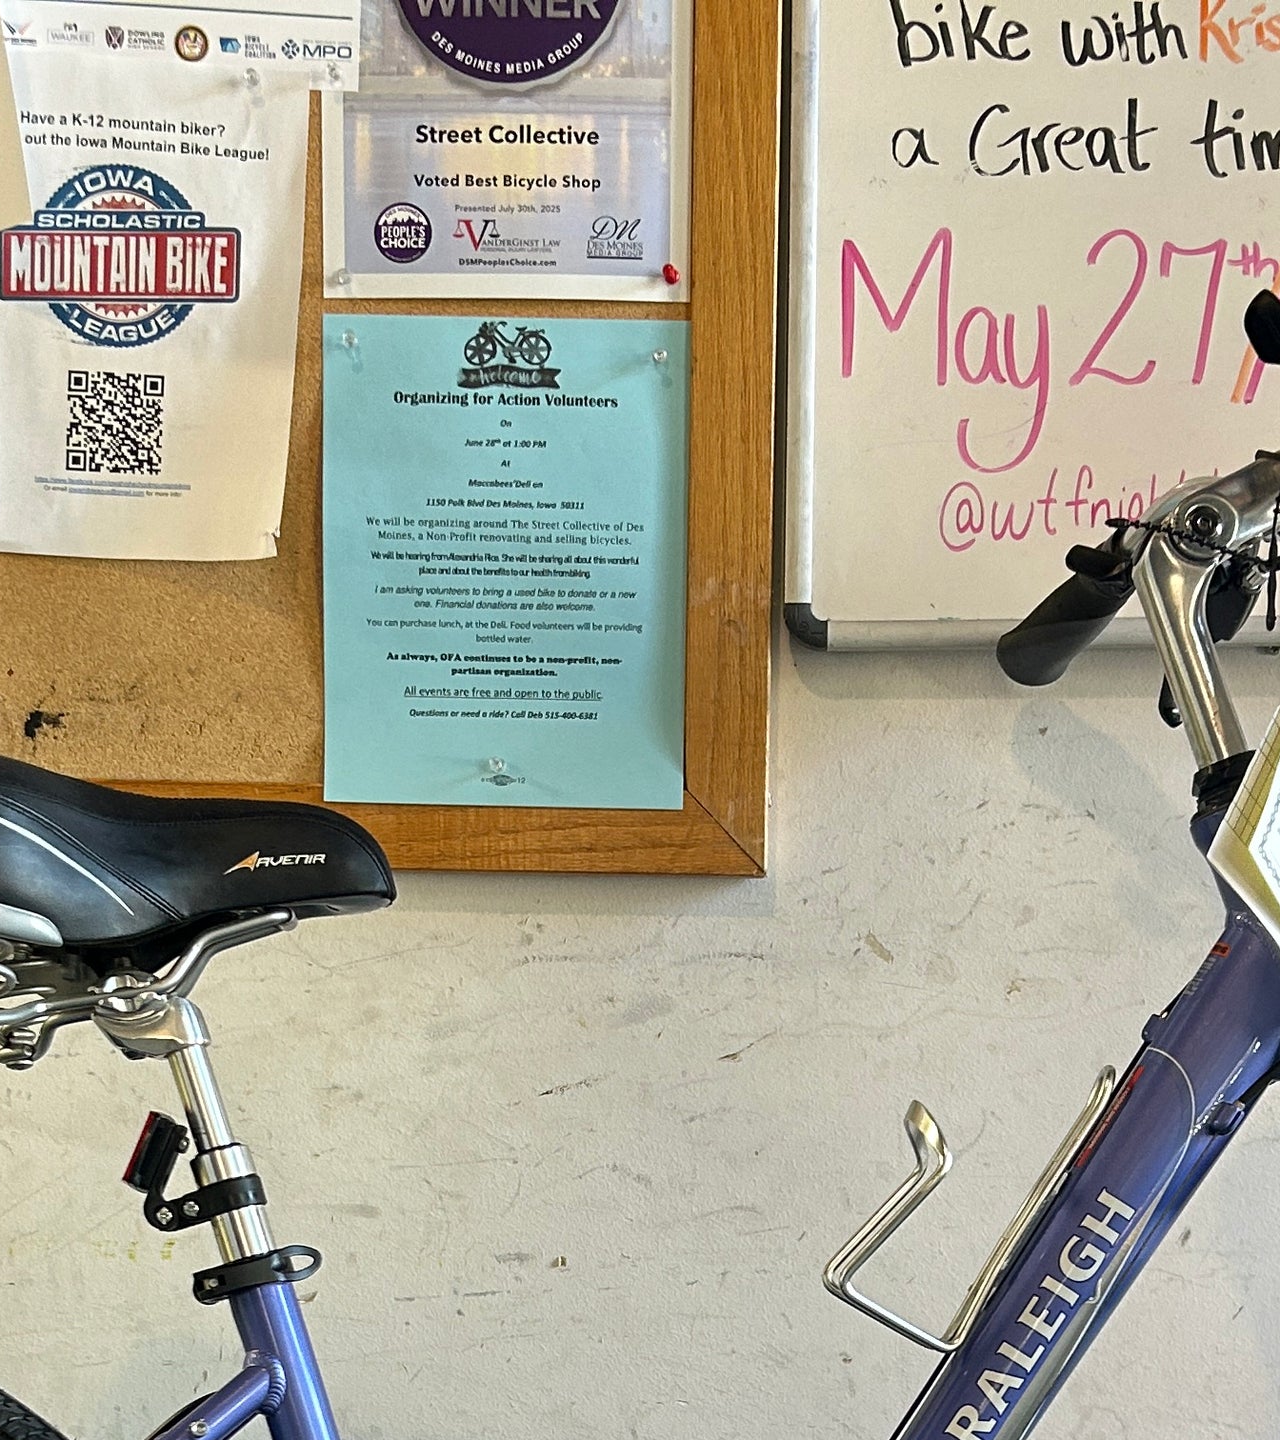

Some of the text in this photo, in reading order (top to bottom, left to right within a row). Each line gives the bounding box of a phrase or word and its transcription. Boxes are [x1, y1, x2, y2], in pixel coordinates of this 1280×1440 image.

[418, 0, 601, 19] WINNER
[889, 0, 1031, 68] bike
[1061, 1, 1188, 67] with
[302, 43, 352, 58] MPO
[431, 31, 584, 75] DES MOINES MEDIA GROUP
[20, 110, 225, 137] Have a K-12 mountain biker?
[415, 124, 599, 145] Street Collective
[891, 127, 939, 168] a
[968, 98, 1159, 177] Great
[24, 133, 269, 162] out the Iowa Mountain Bike League!
[73, 170, 155, 198] IOWA
[413, 173, 601, 192] Voted Best Bicycle Shop
[454, 203, 560, 215] Presented July 30th, 2025
[38, 213, 202, 229] SCHOLASTIC
[380, 237, 425, 249] CHOICE
[10, 234, 228, 294] MOUNTAIN BIKE
[70, 309, 175, 343] LEAGUE
[841, 227, 1050, 472] May
[393, 391, 618, 407] Organizing for Action Volunteers
[499, 419, 512, 427] On
[500, 459, 510, 467] At
[365, 515, 644, 532] We will be organizing around The Street Collective of Des
[403, 686, 417, 697] All
[419, 687, 451, 697] events
[453, 688, 469, 697] are
[471, 686, 491, 697] free
[493, 687, 512, 697] and
[514, 690, 538, 700] open
[541, 689, 551, 698] to
[553, 688, 570, 698] the
[256, 853, 326, 868] AVENIR
